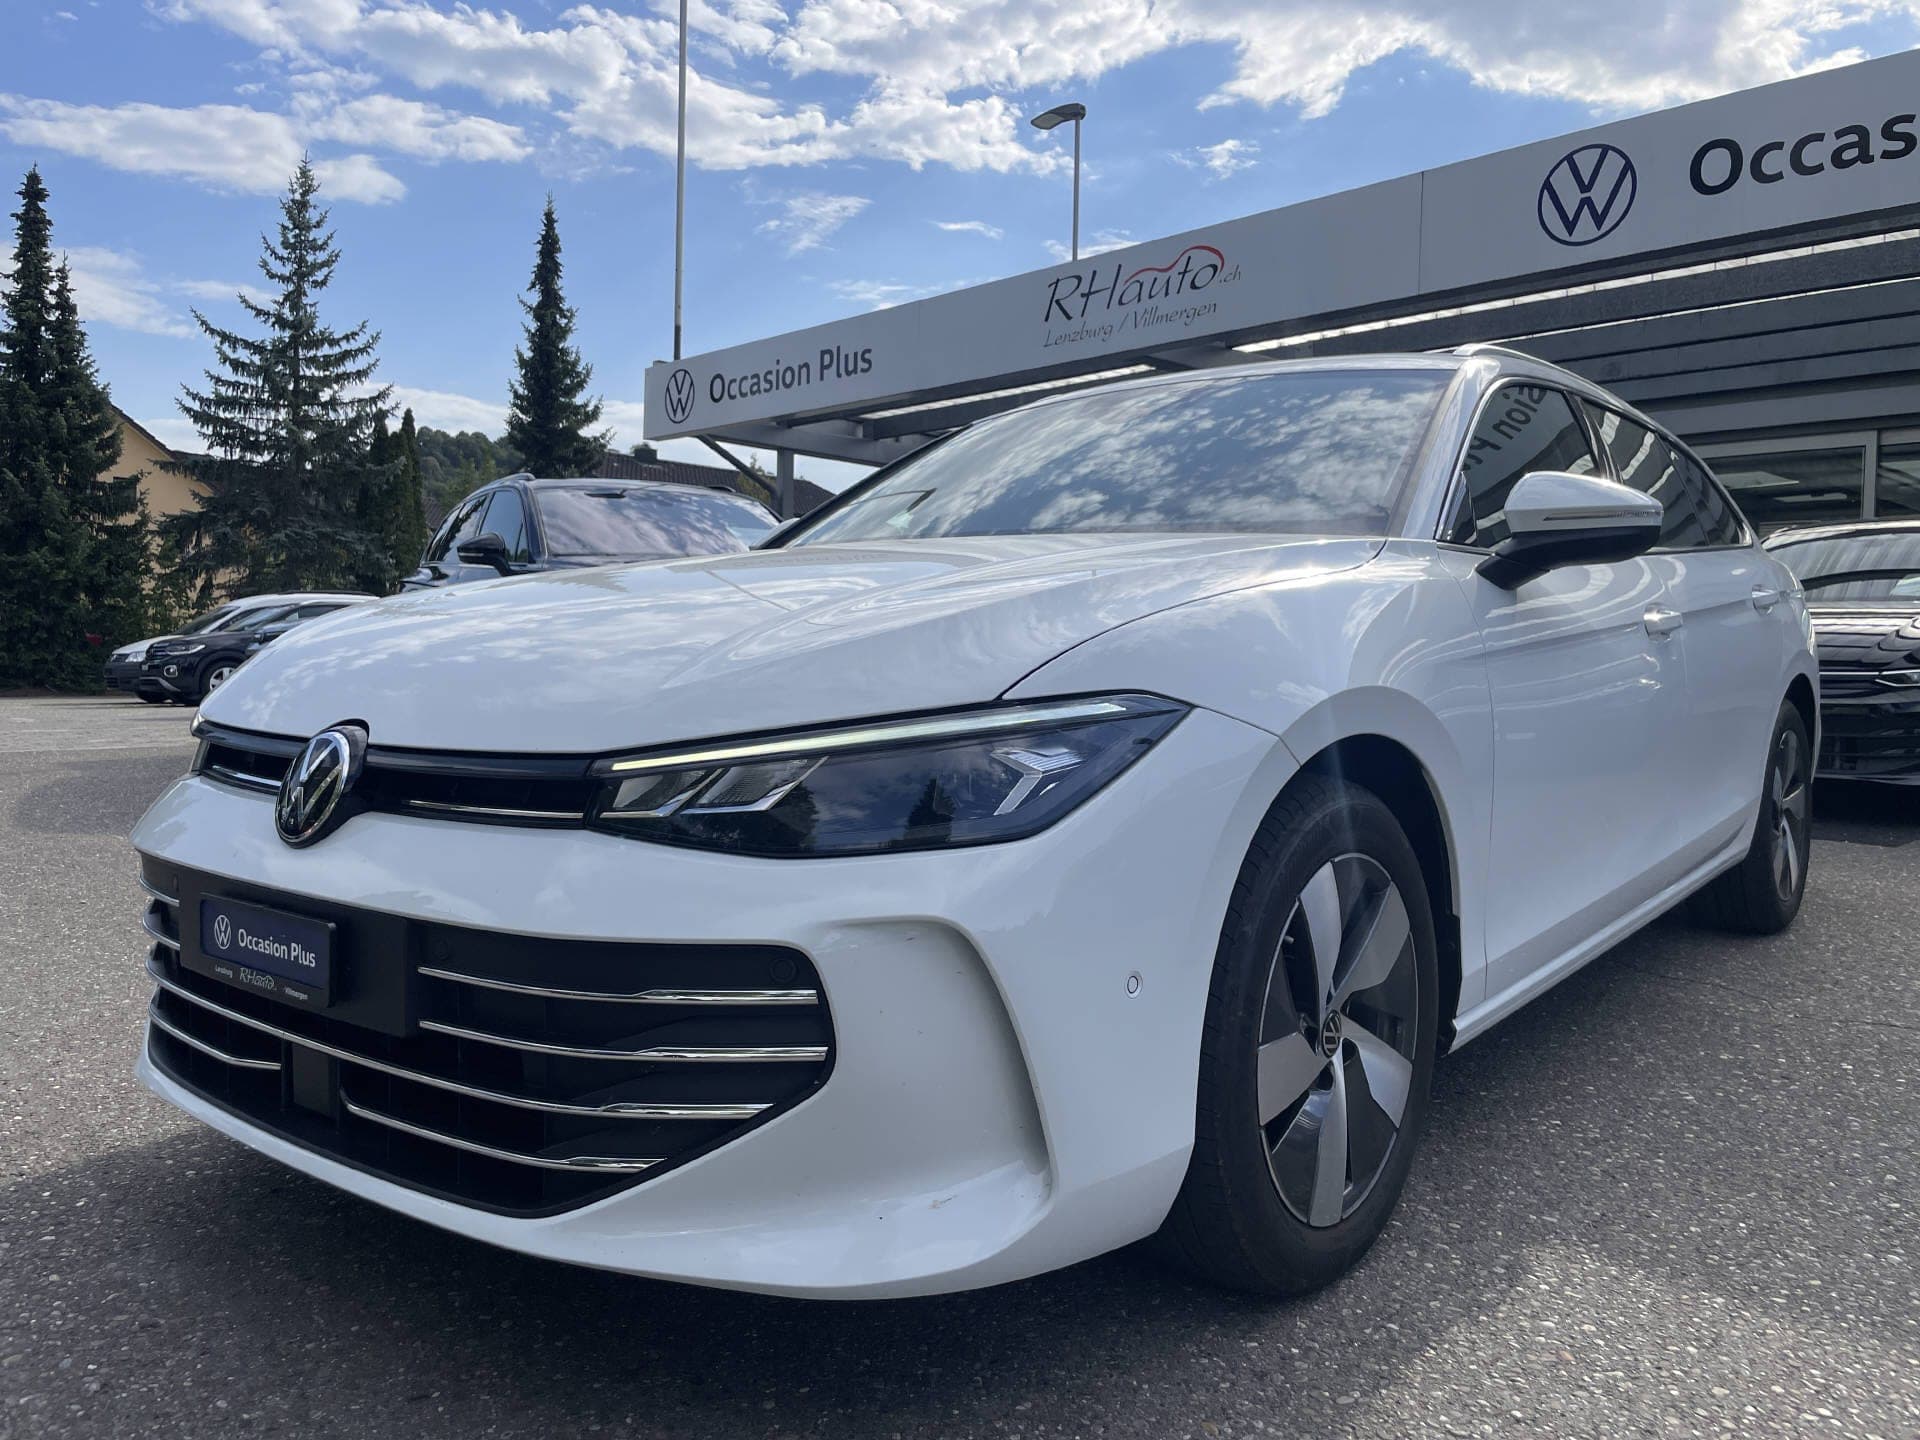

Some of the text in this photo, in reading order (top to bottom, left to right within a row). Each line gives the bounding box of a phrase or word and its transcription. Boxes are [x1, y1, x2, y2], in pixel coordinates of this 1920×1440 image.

[1689, 113, 1919, 196] Occas
[1043, 321, 1113, 348] Lenzburg
[1132, 302, 1217, 328] Villmergen
[709, 359, 811, 403] Occasion
[819, 346, 873, 381] Plus
[238, 928, 288, 960] Occasion
[290, 942, 316, 968] Plus
